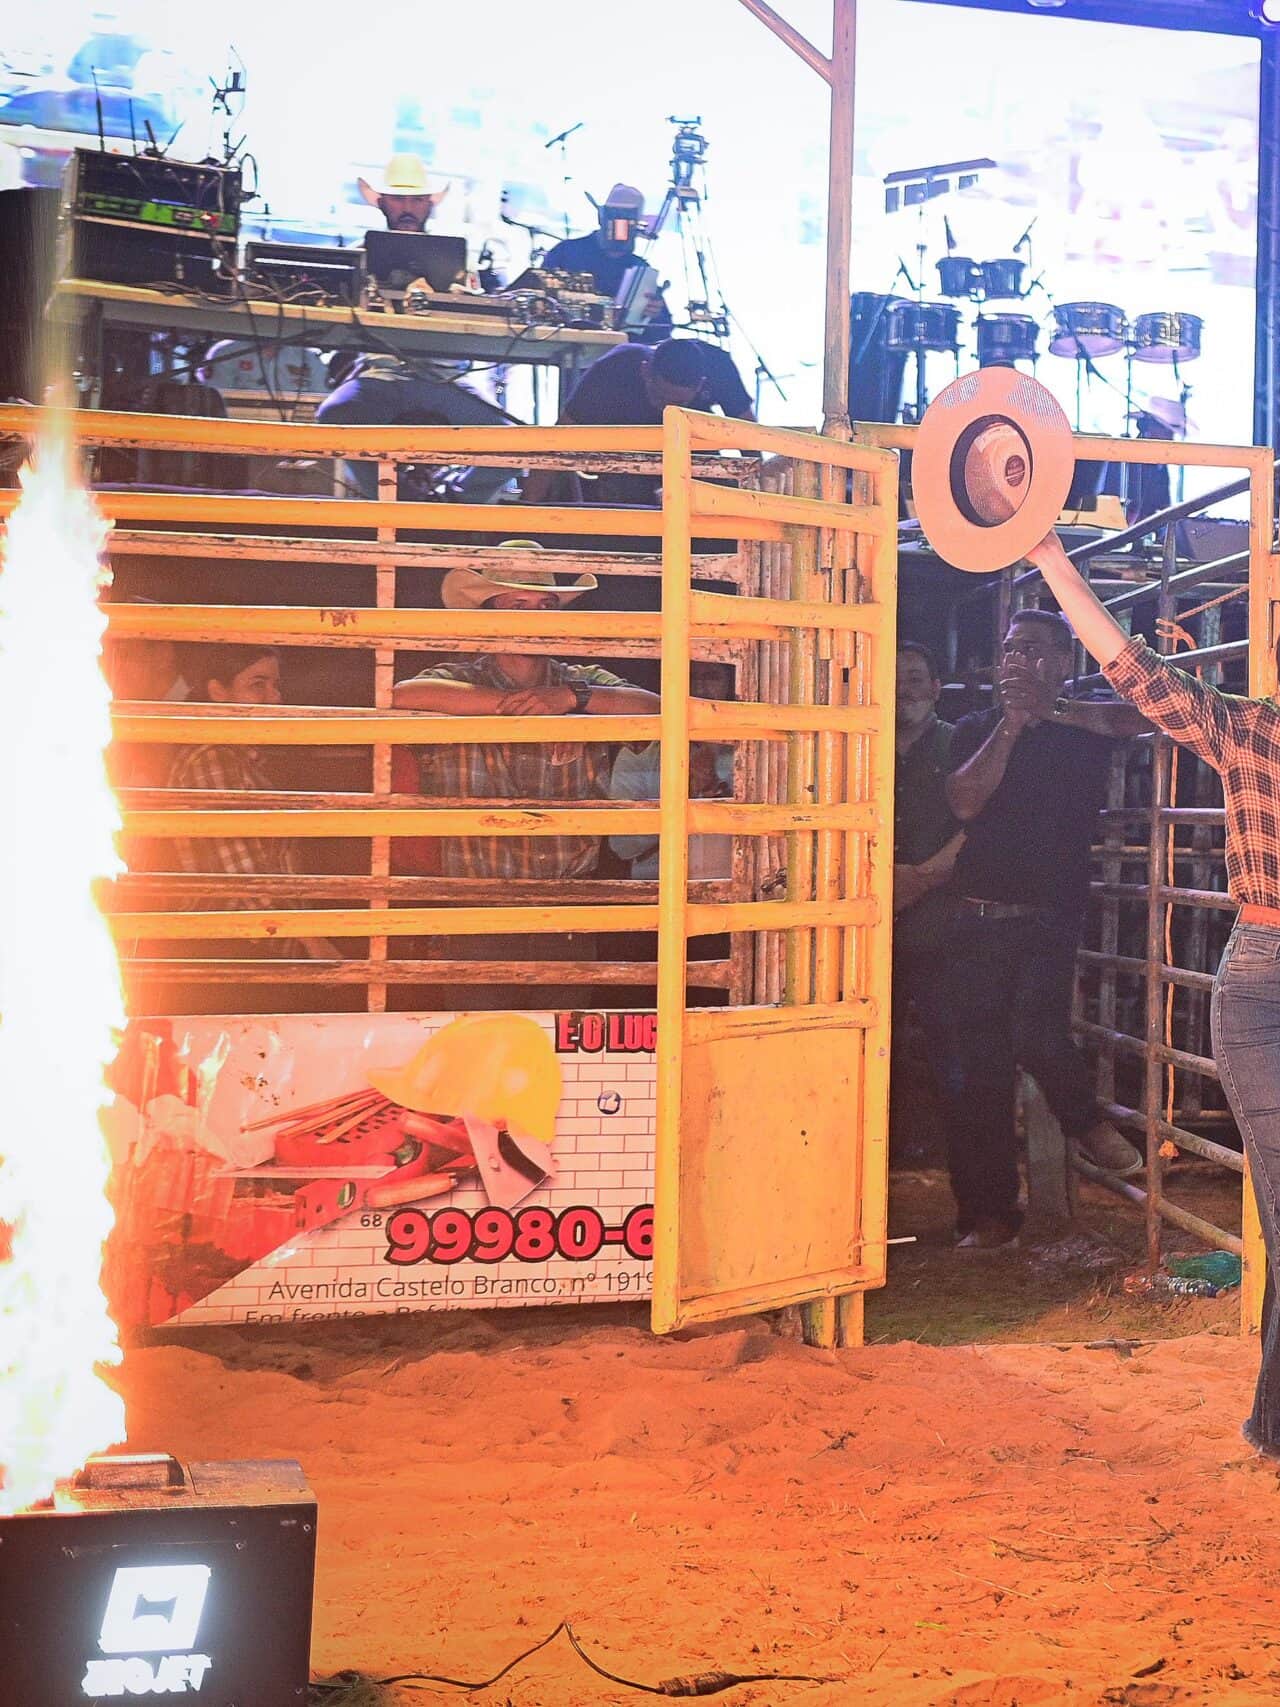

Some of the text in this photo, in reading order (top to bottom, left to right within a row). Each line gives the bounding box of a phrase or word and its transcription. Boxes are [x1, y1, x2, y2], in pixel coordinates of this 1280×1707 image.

[360, 1214, 383, 1228] 68
[268, 1277, 367, 1300] Avenida
[376, 1275, 465, 1297] Castelo
[474, 1275, 562, 1296] Branco,
